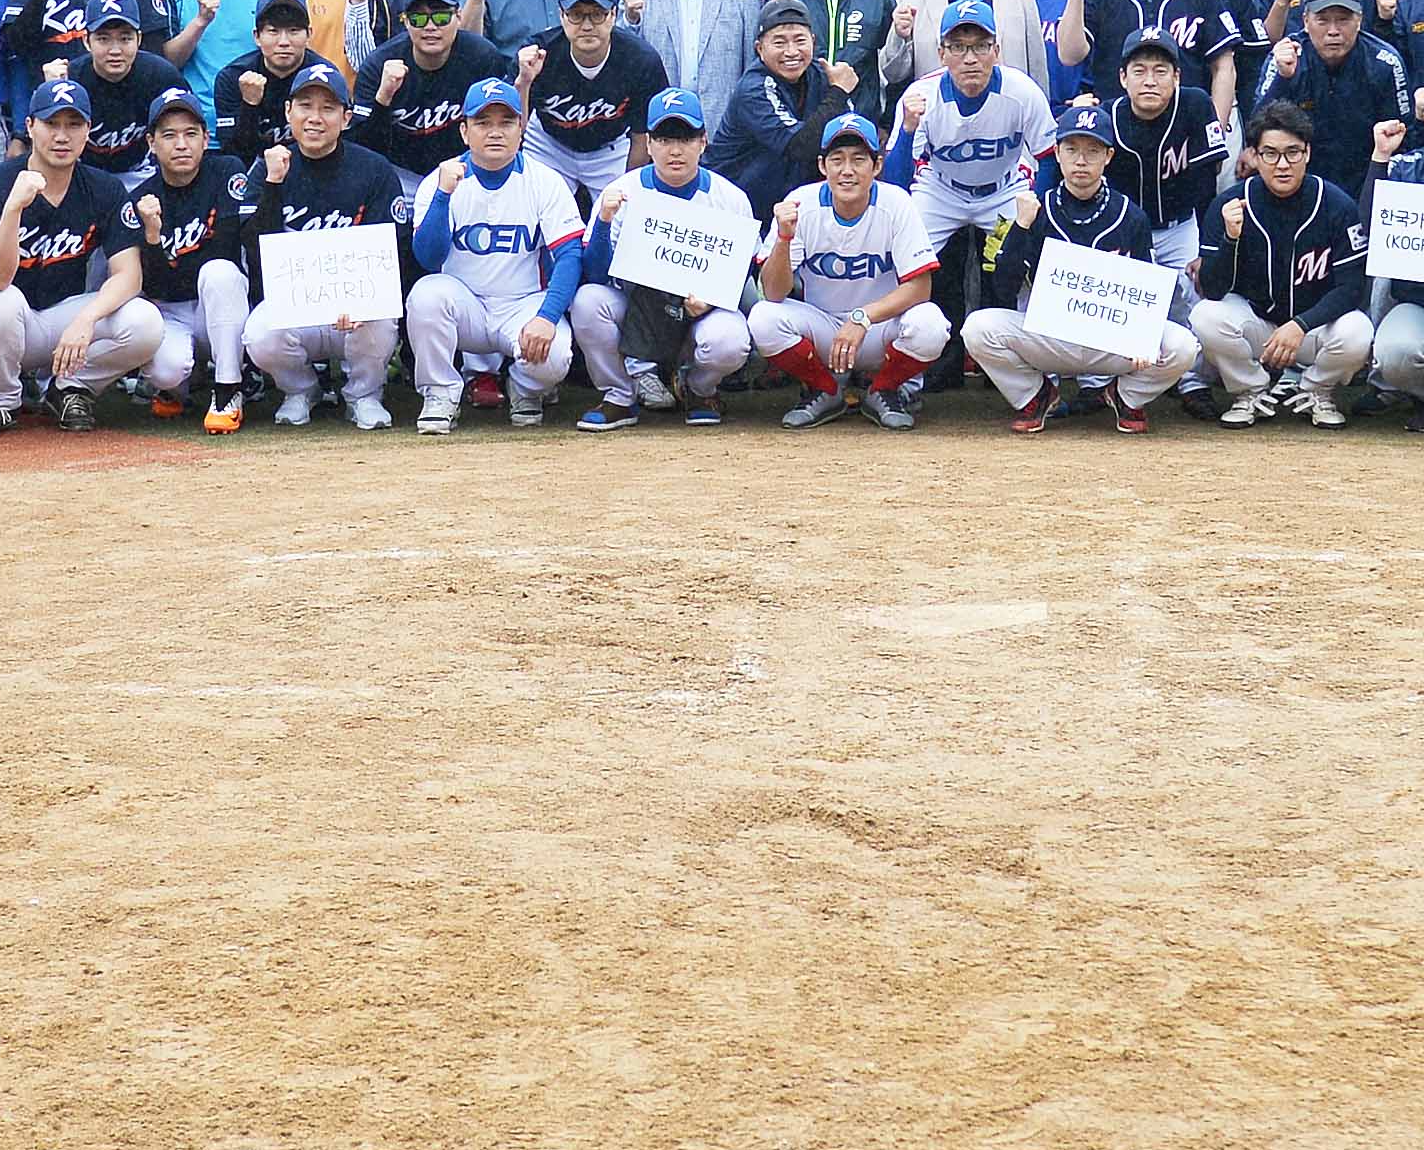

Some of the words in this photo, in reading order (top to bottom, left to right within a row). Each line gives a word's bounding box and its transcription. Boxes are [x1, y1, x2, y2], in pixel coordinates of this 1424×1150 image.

[932, 132, 1023, 162] KOEN
[453, 223, 541, 255] KOEN
[644, 217, 733, 257] 한국남동발전
[655, 245, 709, 273] (KOEN)
[805, 251, 893, 279] KOEN
[1050, 268, 1157, 308] 산업통상자원부
[1067, 298, 1128, 325] (MOTIE)
